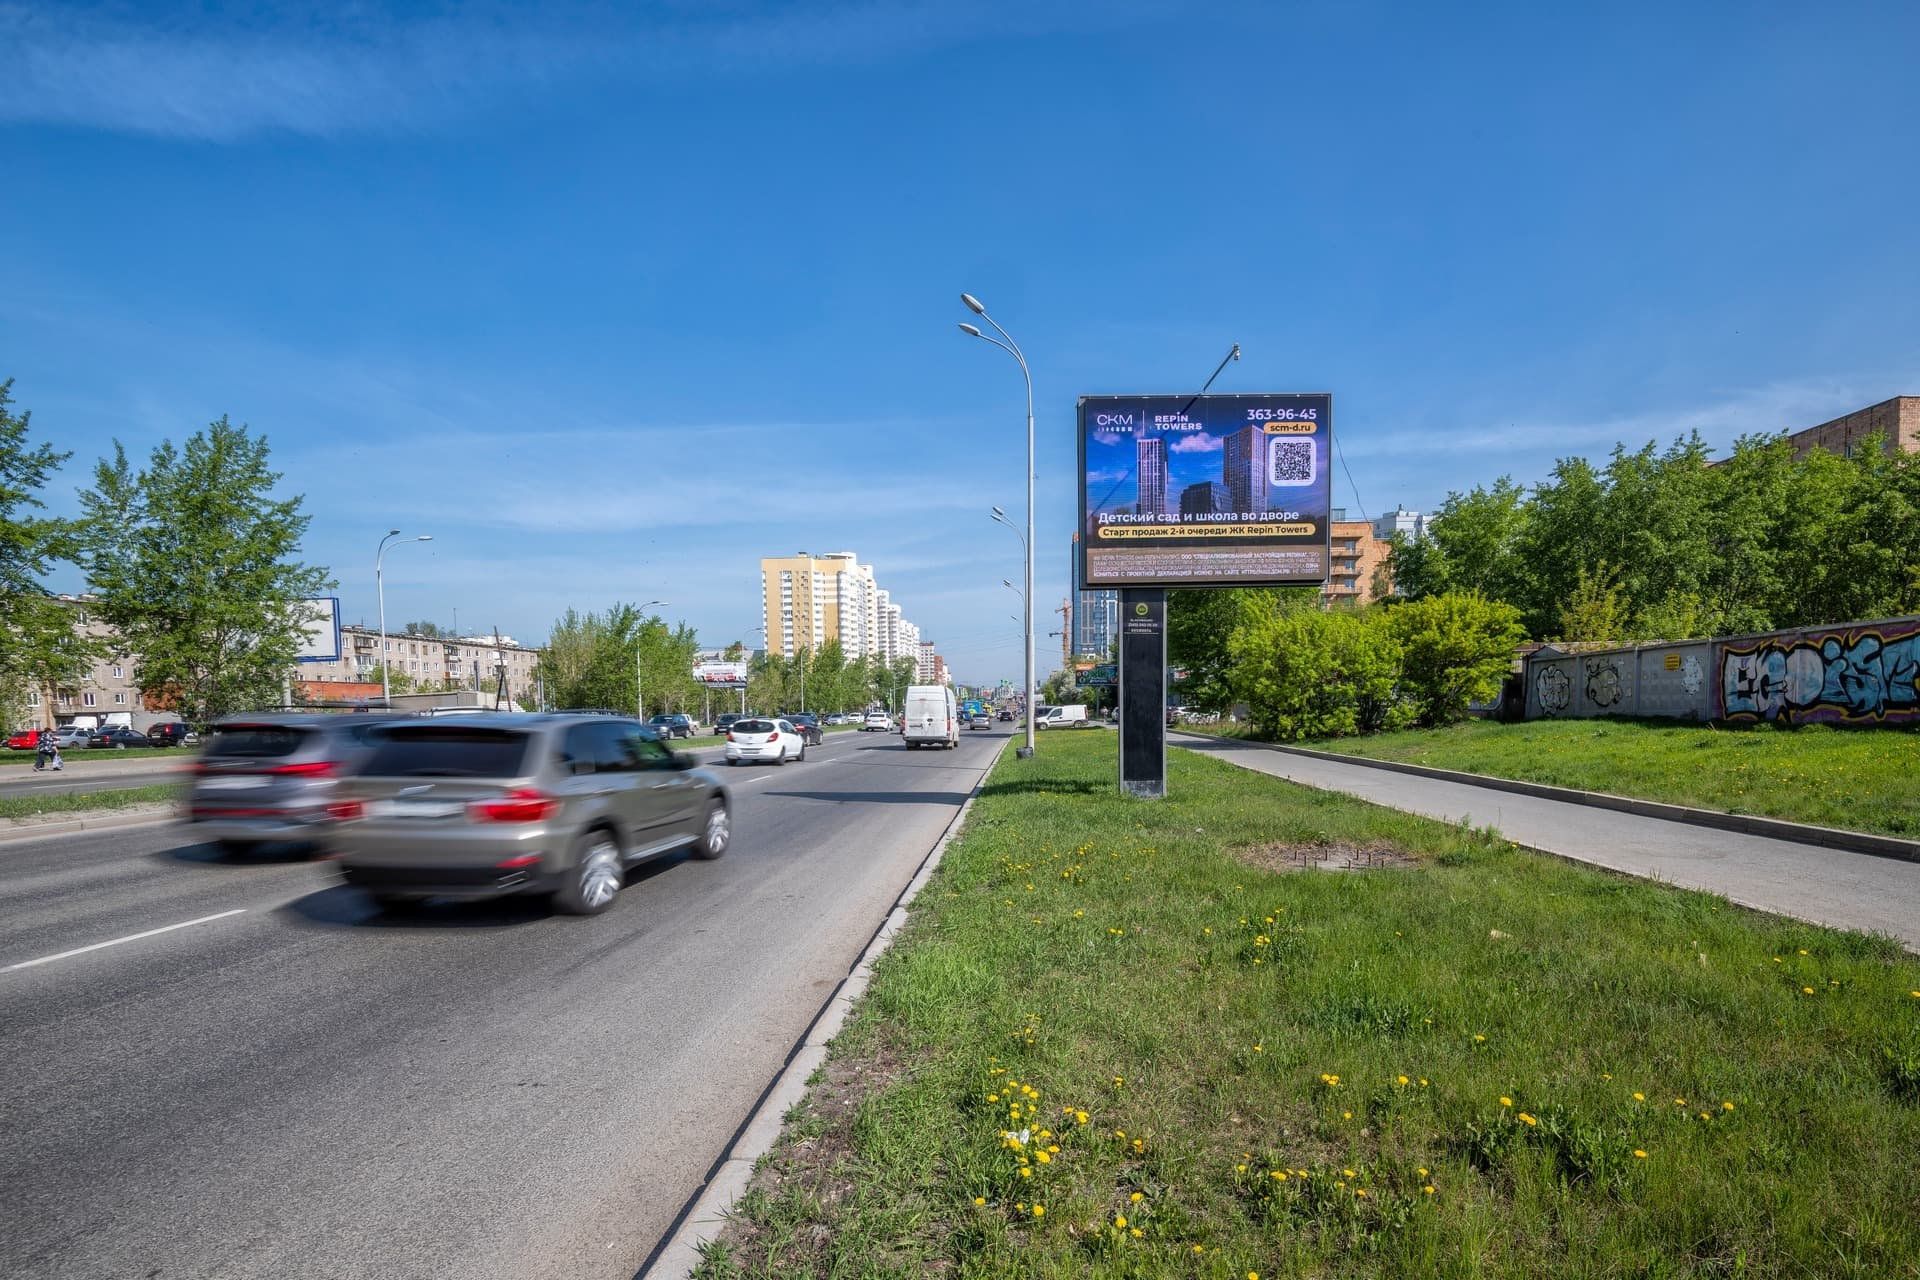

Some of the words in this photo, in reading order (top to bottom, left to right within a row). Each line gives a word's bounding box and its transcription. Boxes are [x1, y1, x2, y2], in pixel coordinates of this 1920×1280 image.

[1247, 409, 1317, 420] 363-96-45
[1270, 424, 1311, 432] scm-d.ru
[1098, 512, 1154, 524] Детский
[1157, 514, 1180, 523] сад
[1184, 513, 1192, 521] и
[1196, 512, 1238, 521] школа
[1241, 511, 1257, 520] во
[1260, 511, 1299, 522] дворе
[1103, 528, 1129, 537] Старт
[1132, 528, 1168, 538] продаж
[1170, 527, 1185, 535] 2-й
[1187, 527, 1227, 536] очереди
[1230, 526, 1245, 534] ЖК
[1247, 525, 1274, 536] Repin
[1275, 524, 1308, 534] Towers
